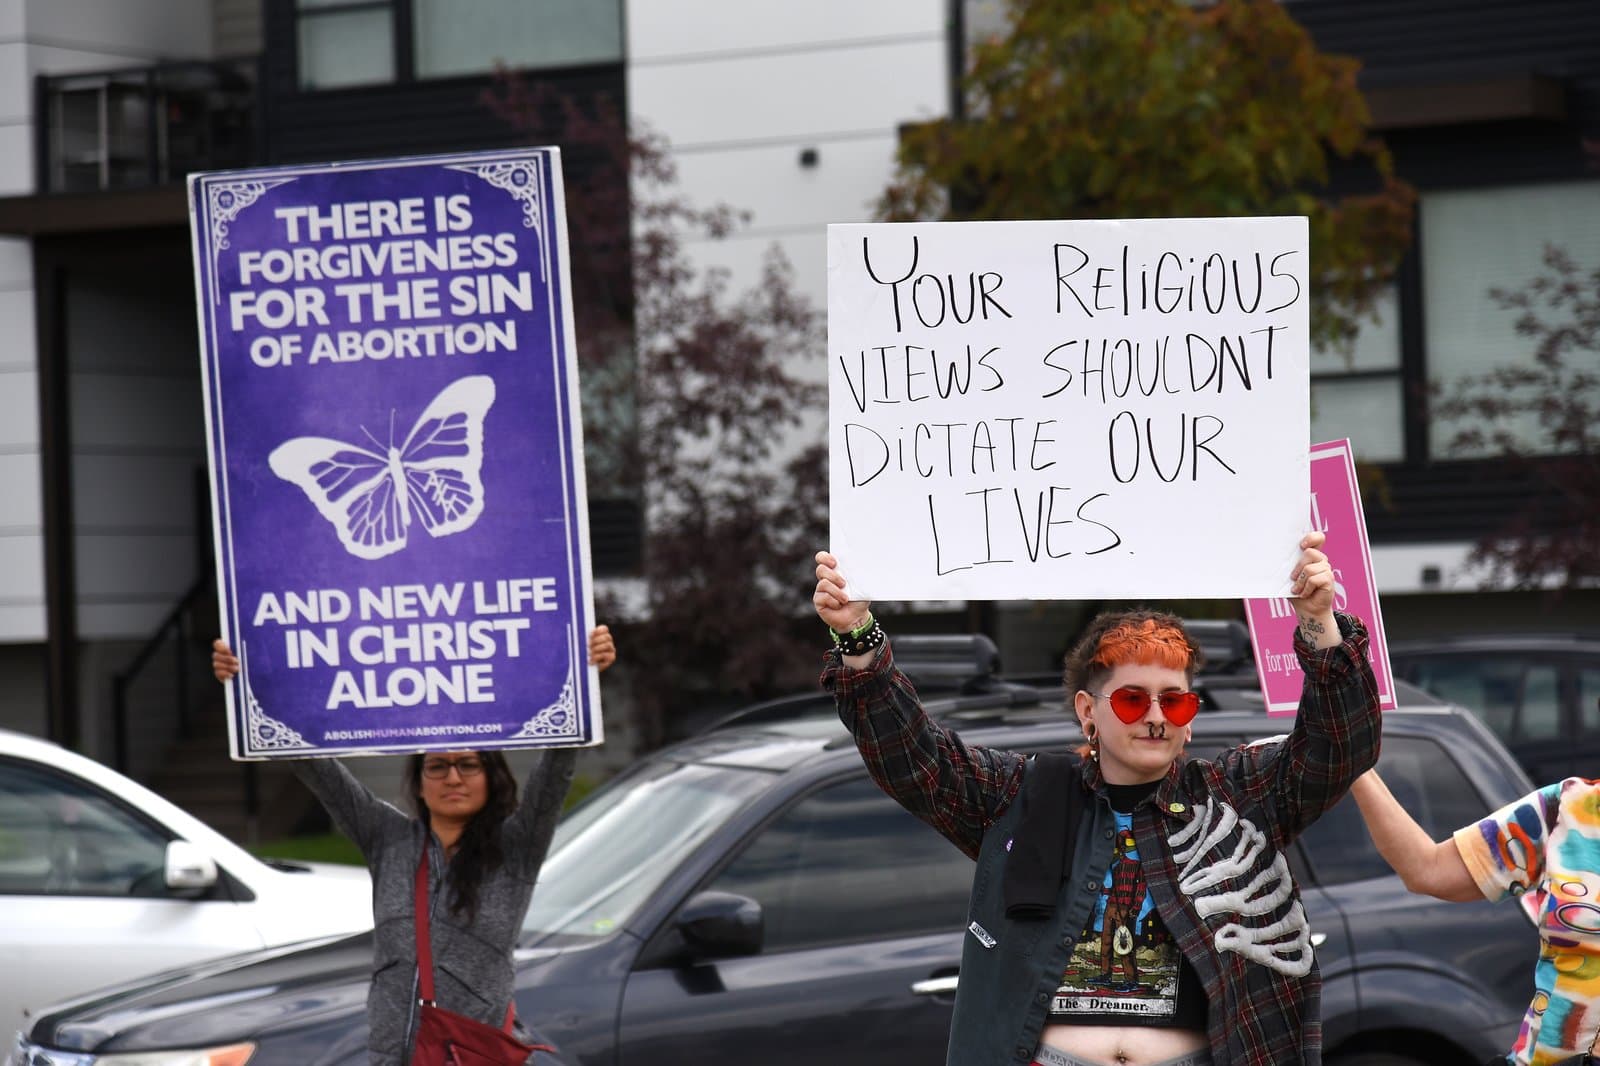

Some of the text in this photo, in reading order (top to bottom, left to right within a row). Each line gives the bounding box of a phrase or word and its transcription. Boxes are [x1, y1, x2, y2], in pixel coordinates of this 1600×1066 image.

[275, 195, 473, 243] THERE IS
[238, 233, 518, 285] FORGIVENESS
[230, 272, 533, 331] FOR THE SIN
[863, 236, 1013, 333] YOUR
[250, 320, 517, 368] OF ABORTION
[839, 325, 1288, 413] VIEWS SHOULDNT
[1108, 410, 1236, 484] OUR
[928, 486, 1135, 576] LIVES.
[253, 577, 558, 626] AND NEW LIFE
[285, 618, 530, 669] IN CHRIST
[1265, 648, 1282, 673] for
[326, 664, 495, 710] ALONE
[324, 723, 502, 741] ABOLISHHUMANABORTION.COM
[1056, 998, 1149, 1011] The Dreamer.
